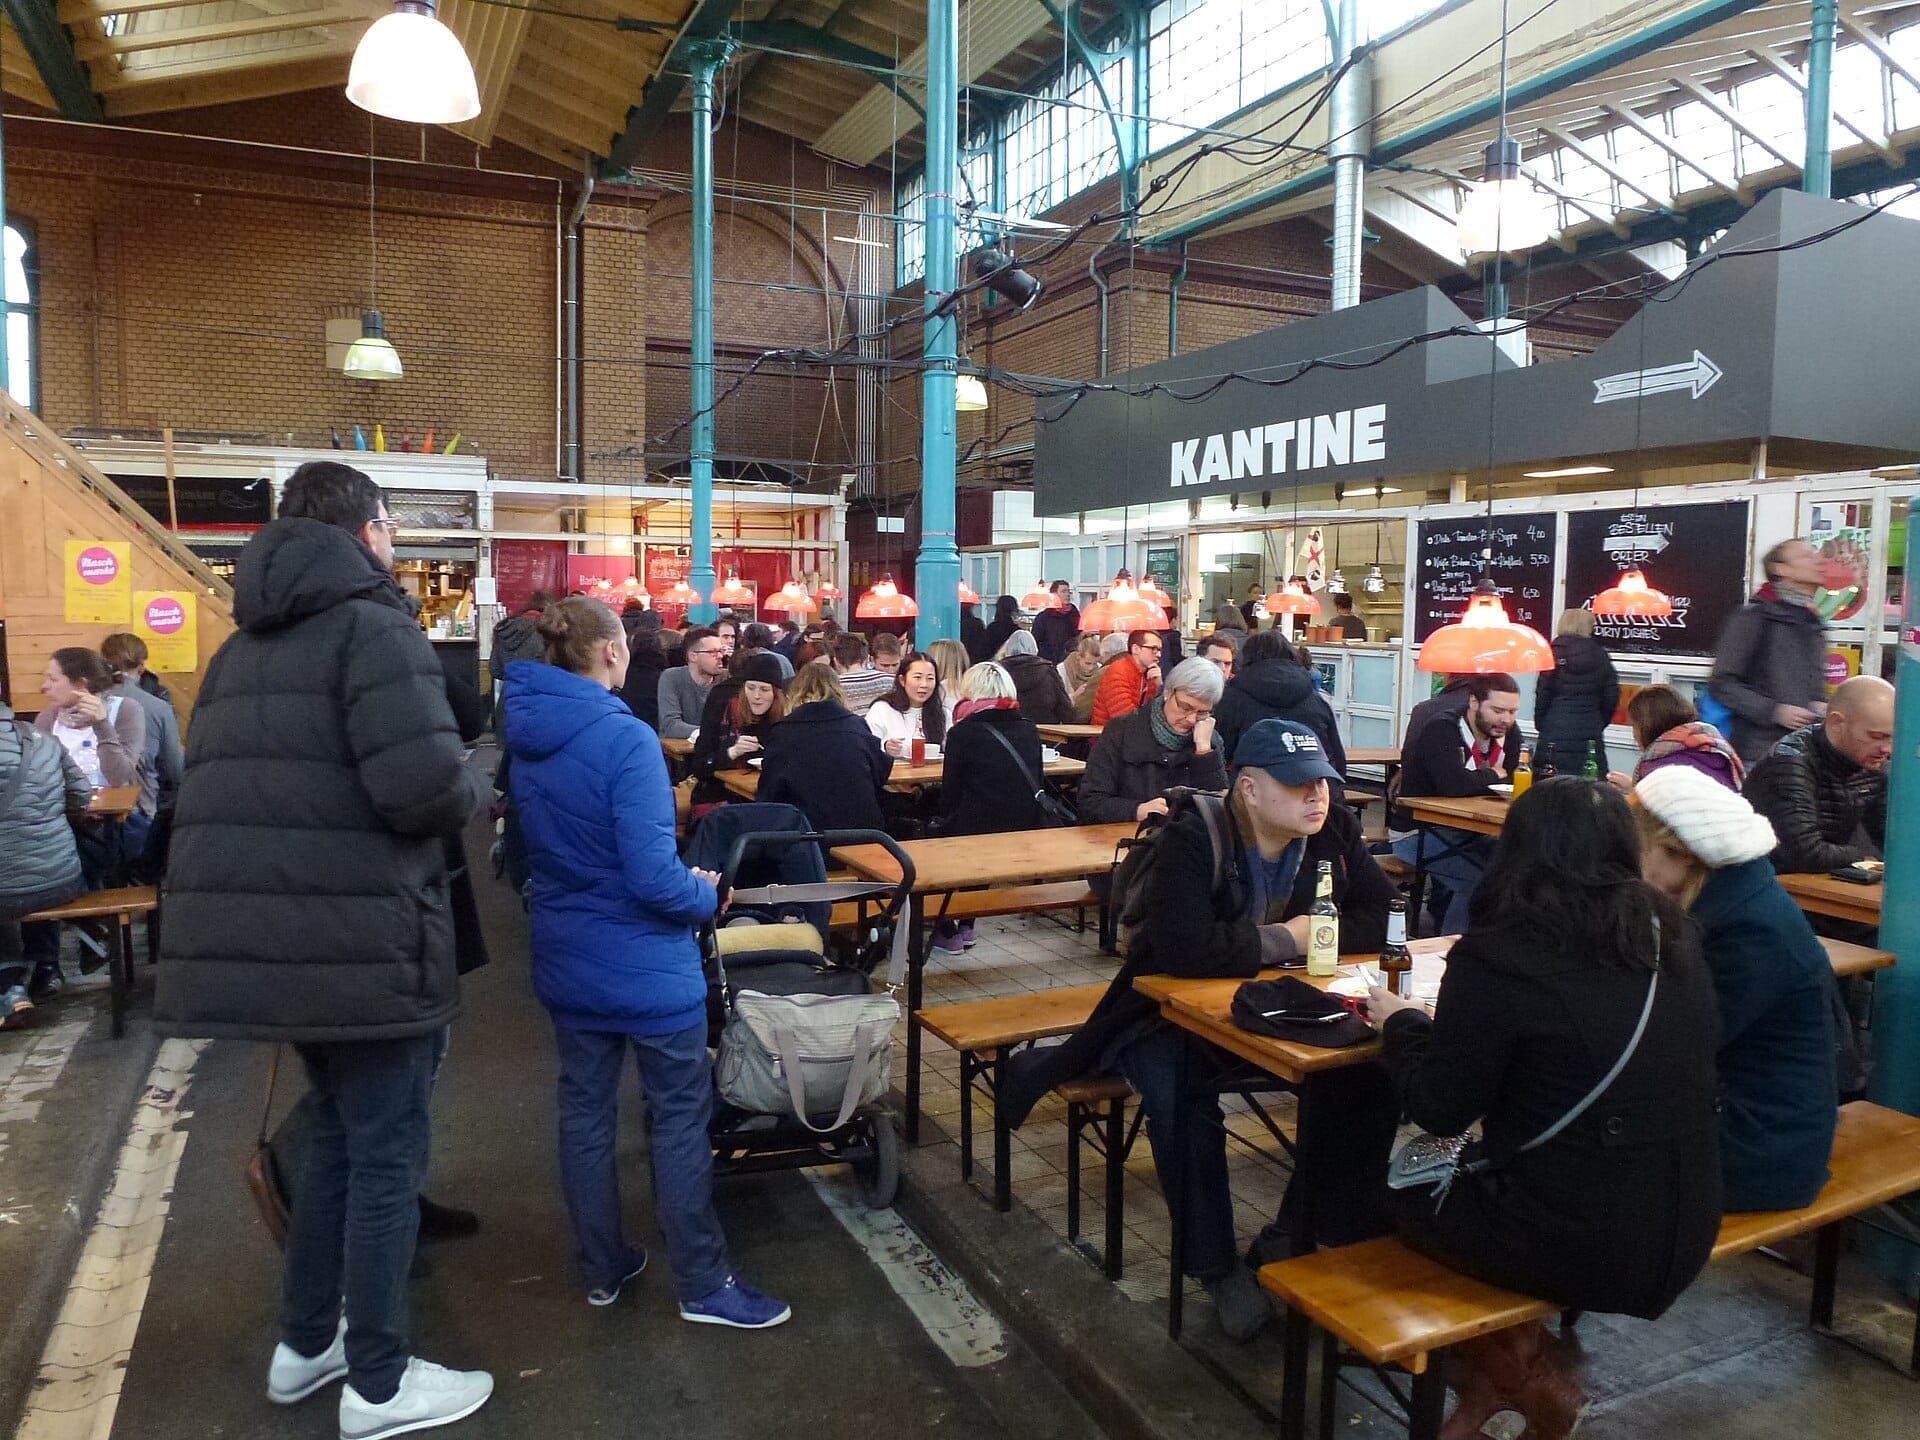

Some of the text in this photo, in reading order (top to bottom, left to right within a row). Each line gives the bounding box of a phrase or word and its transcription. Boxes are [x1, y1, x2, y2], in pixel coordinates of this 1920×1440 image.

[1170, 403, 1386, 487] KANTINE
[1608, 522, 1674, 536] BESTELLEN
[1529, 553, 1550, 567] 5,50
[1610, 550, 1654, 564] ORDER
[1594, 625, 1661, 641] DIRTY DISHES
